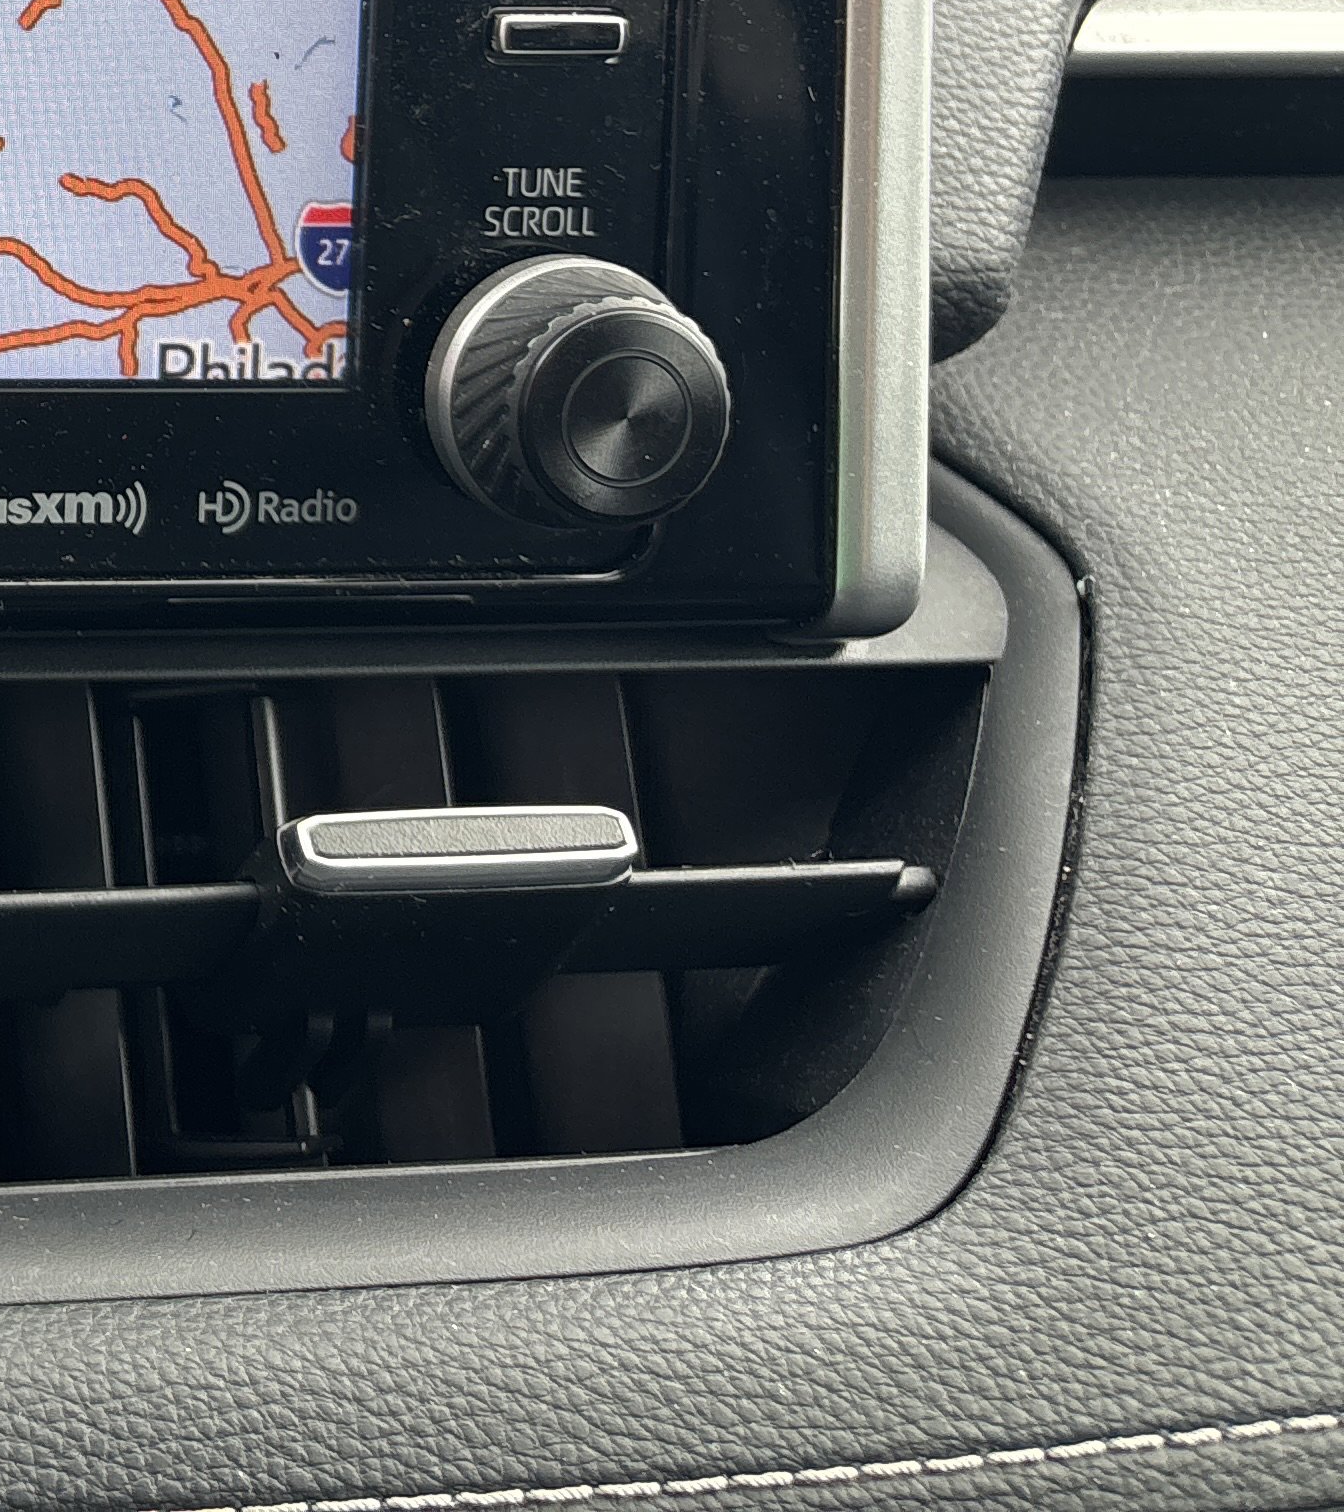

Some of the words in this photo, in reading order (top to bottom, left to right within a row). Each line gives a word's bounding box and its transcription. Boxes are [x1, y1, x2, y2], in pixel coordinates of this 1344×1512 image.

[503, 168, 582, 197] TUNE
[484, 207, 595, 236] SCROLL
[318, 239, 350, 265] 27
[199, 486, 250, 528] HD
[258, 490, 357, 523] Radio
